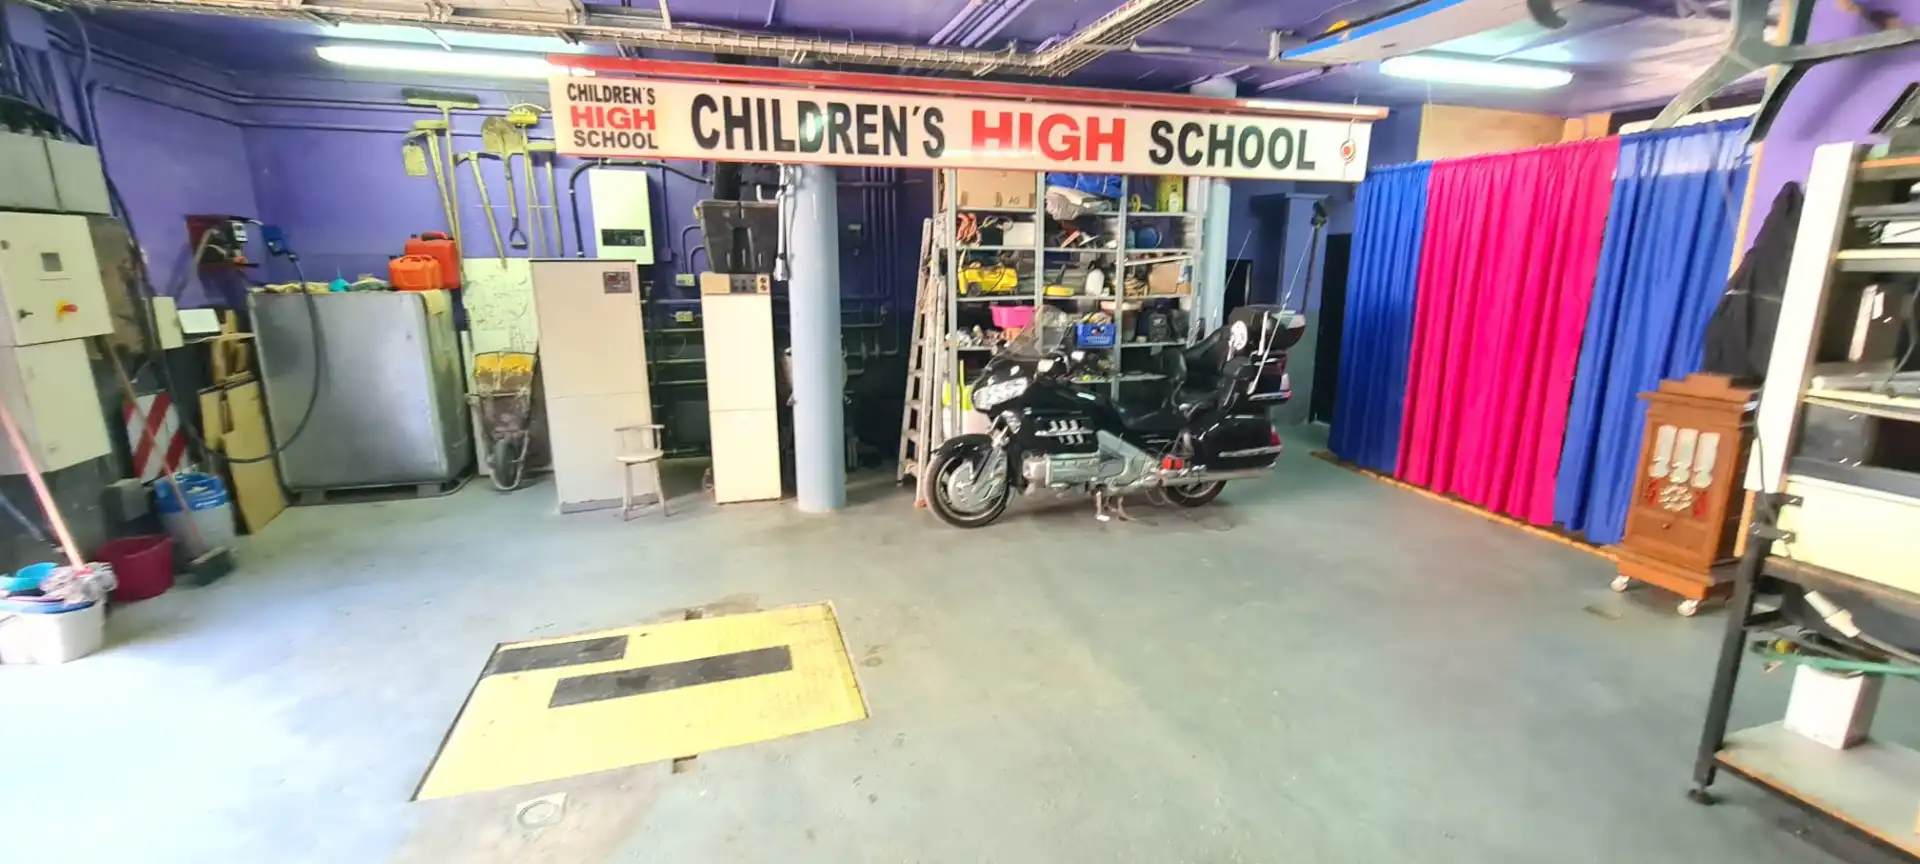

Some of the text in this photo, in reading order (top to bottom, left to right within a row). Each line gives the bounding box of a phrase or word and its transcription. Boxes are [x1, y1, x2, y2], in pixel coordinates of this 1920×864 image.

[570, 106, 656, 131] HIGH
[573, 129, 659, 150] SCHOOL
[971, 110, 1127, 163] HIGH
[1148, 120, 1316, 170] SCHOOL
